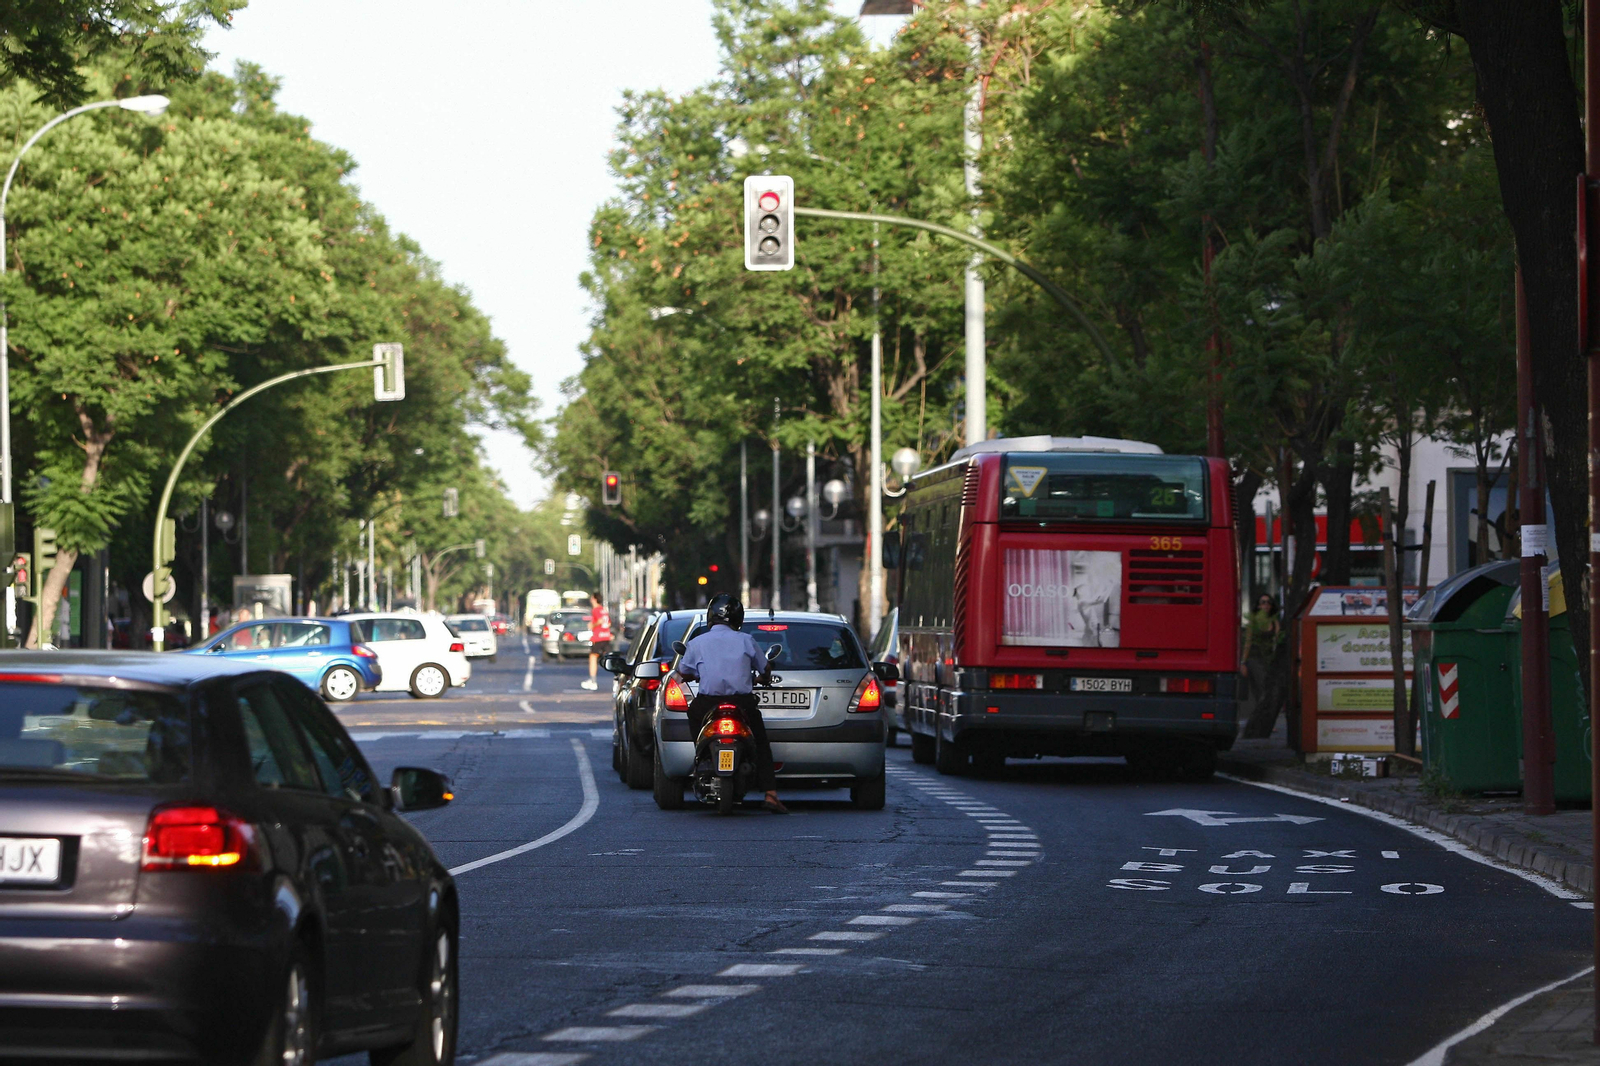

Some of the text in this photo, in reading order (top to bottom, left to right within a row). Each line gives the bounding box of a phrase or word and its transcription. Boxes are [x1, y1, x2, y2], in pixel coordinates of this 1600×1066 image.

[1150, 536, 1182, 551] 365
[1008, 583, 1069, 598] OCASO
[1081, 679, 1131, 690] 1502 BYH
[782, 692, 806, 704] FDD
[1141, 846, 1400, 859] TAXI
[1119, 861, 1356, 875] BUS
[1106, 878, 1445, 895] SOLO
